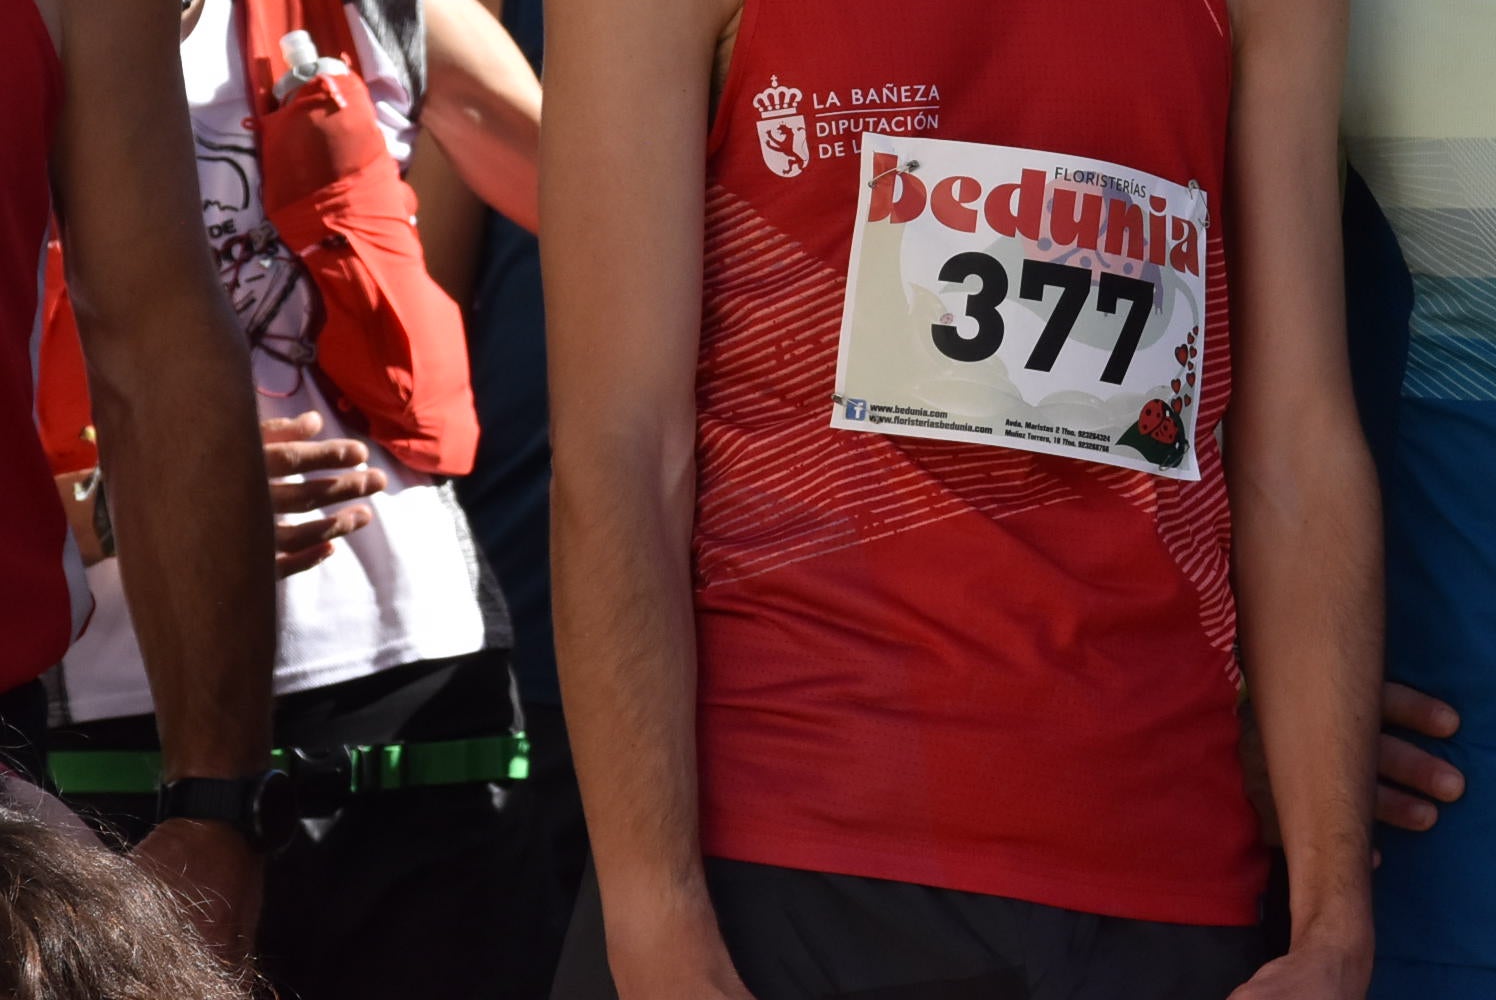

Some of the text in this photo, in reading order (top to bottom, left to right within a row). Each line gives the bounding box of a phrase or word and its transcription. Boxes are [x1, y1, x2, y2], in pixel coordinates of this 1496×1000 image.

[813, 83, 940, 109] LA BAÑEZA
[816, 112, 939, 137] DIPUTACIÓN
[819, 142, 845, 159] DE
[1054, 166, 1146, 199] FLORISTERÍAS
[867, 152, 1200, 278] bedunia
[931, 251, 1155, 386] 377
[869, 402, 949, 419] www.bedunia.com
[868, 413, 994, 435] www.floristeriasbedunia.com
